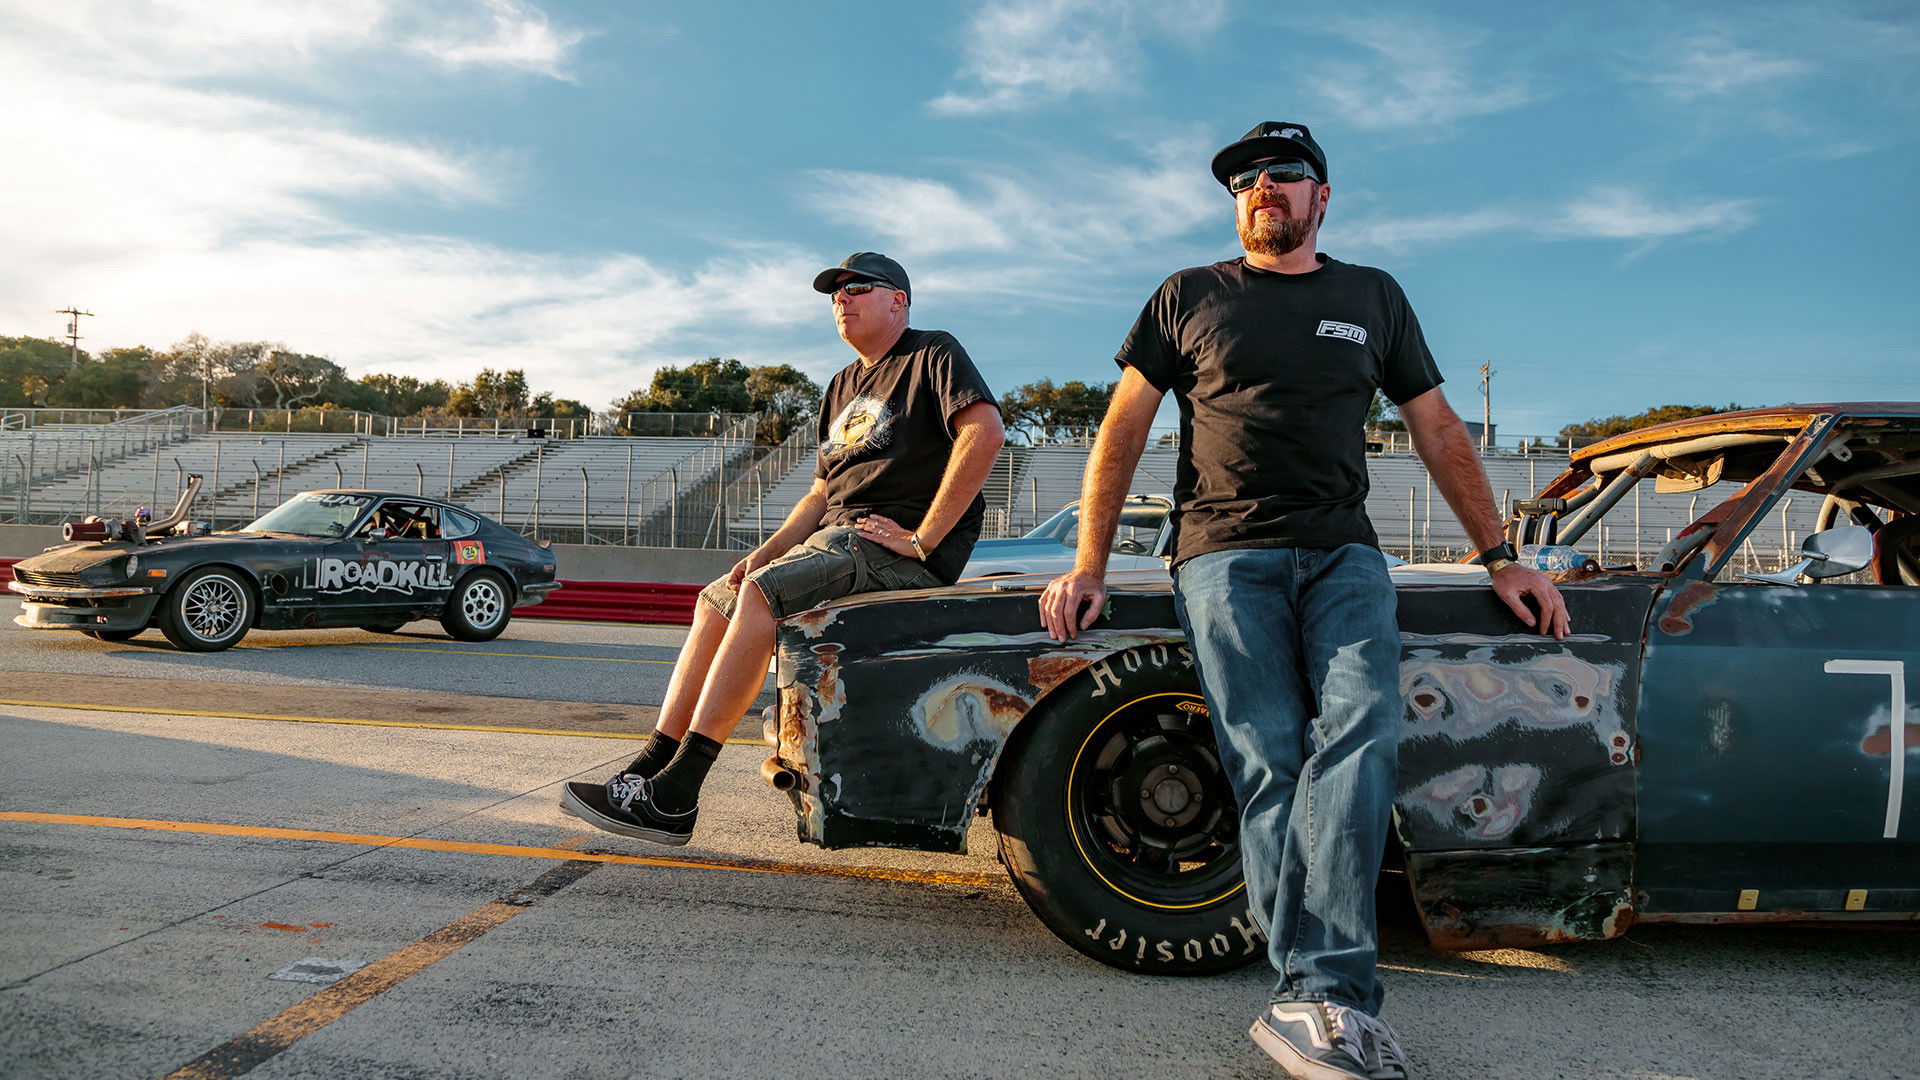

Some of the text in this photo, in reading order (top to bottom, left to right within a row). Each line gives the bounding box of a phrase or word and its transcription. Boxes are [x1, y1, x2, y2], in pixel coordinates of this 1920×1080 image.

[1320, 323, 1365, 341] FSM
[320, 558, 453, 591] ROADKILL
[1183, 703, 1208, 714] AERO
[1824, 660, 1904, 837] 7
[1084, 909, 1269, 965] Hoosier
